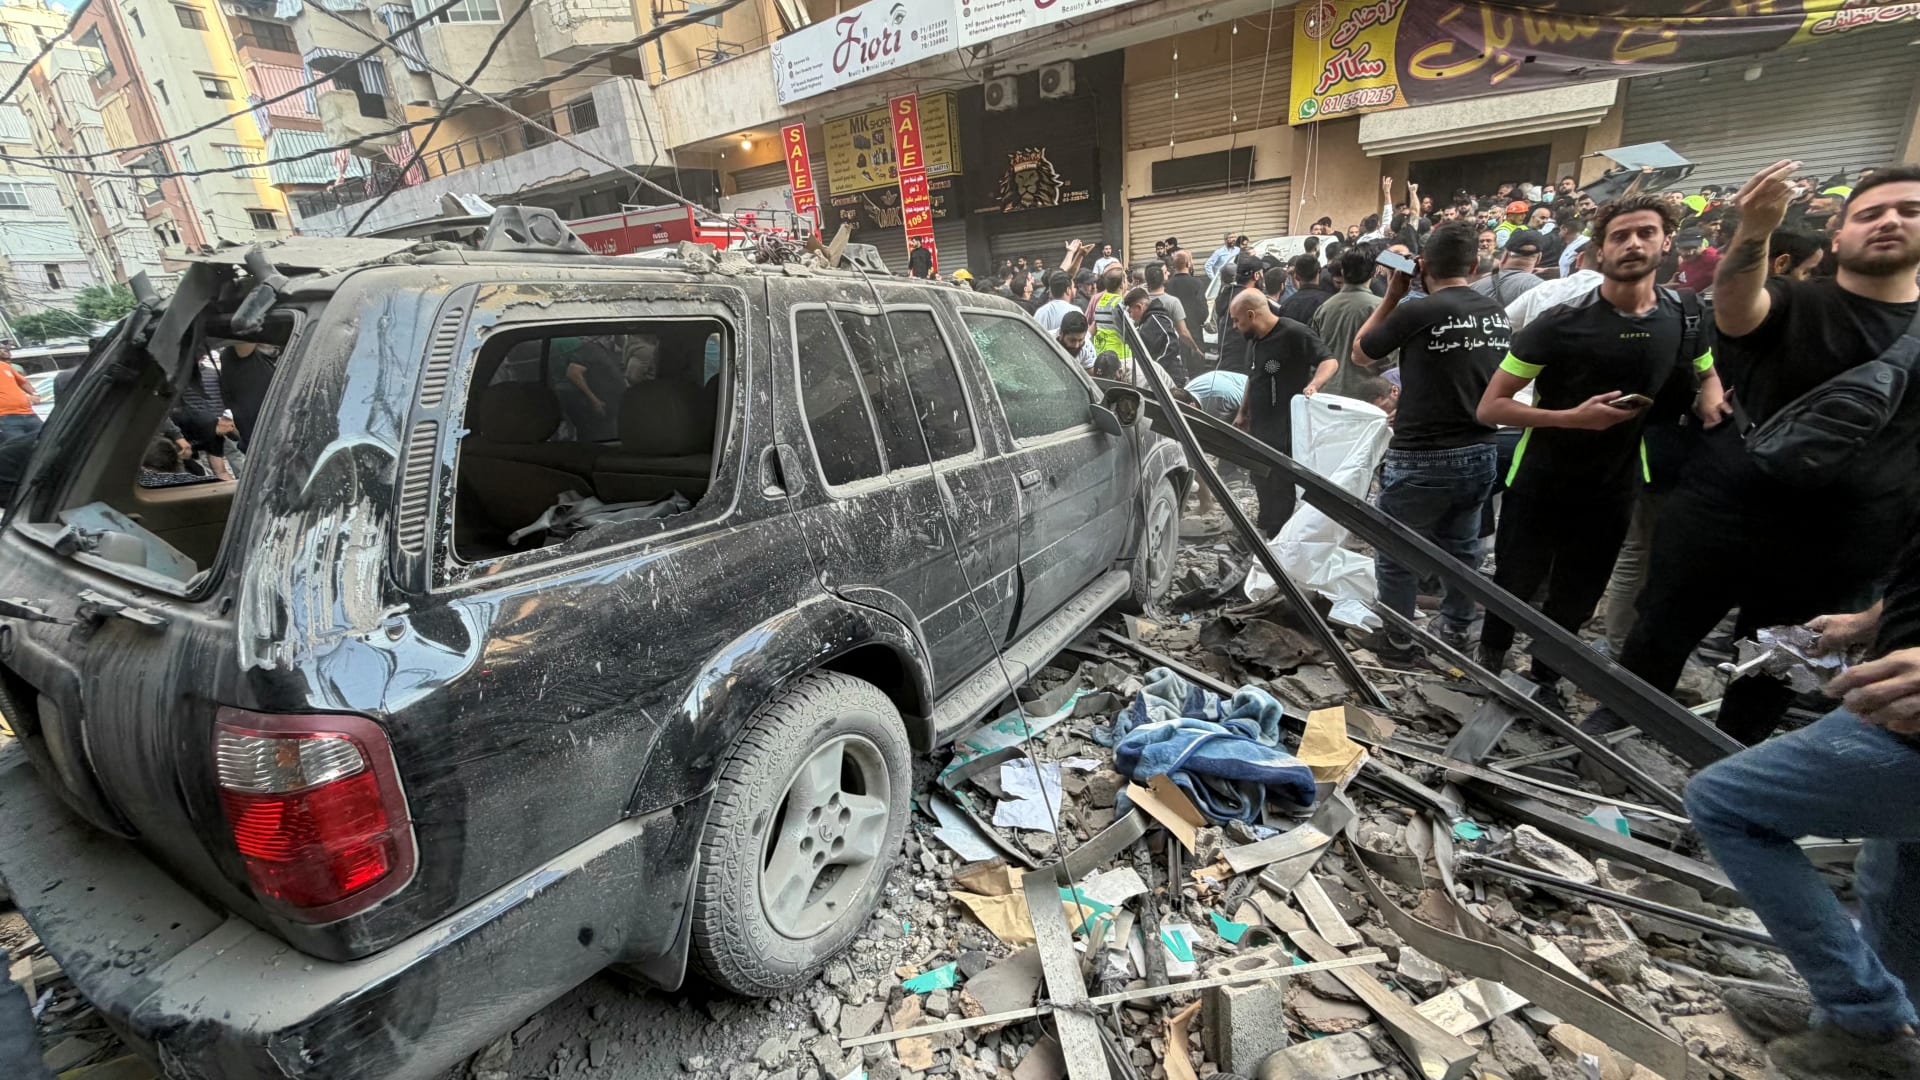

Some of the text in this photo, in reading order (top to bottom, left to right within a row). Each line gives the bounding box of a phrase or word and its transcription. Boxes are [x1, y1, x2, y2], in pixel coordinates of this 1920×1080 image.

[833, 11, 902, 73] Fiori
[1315, 42, 1384, 94] سكاكر
[1322, 86, 1394, 114] 81/550215
[849, 114, 892, 134] MK SHOPP
[899, 99, 916, 167] SALE
[789, 128, 807, 189] SALE
[908, 214, 922, 227] 109
[1431, 313, 1510, 336] لدفاع المدني
[1428, 339, 1460, 352] حريك
[1464, 336, 1485, 351] حارة
